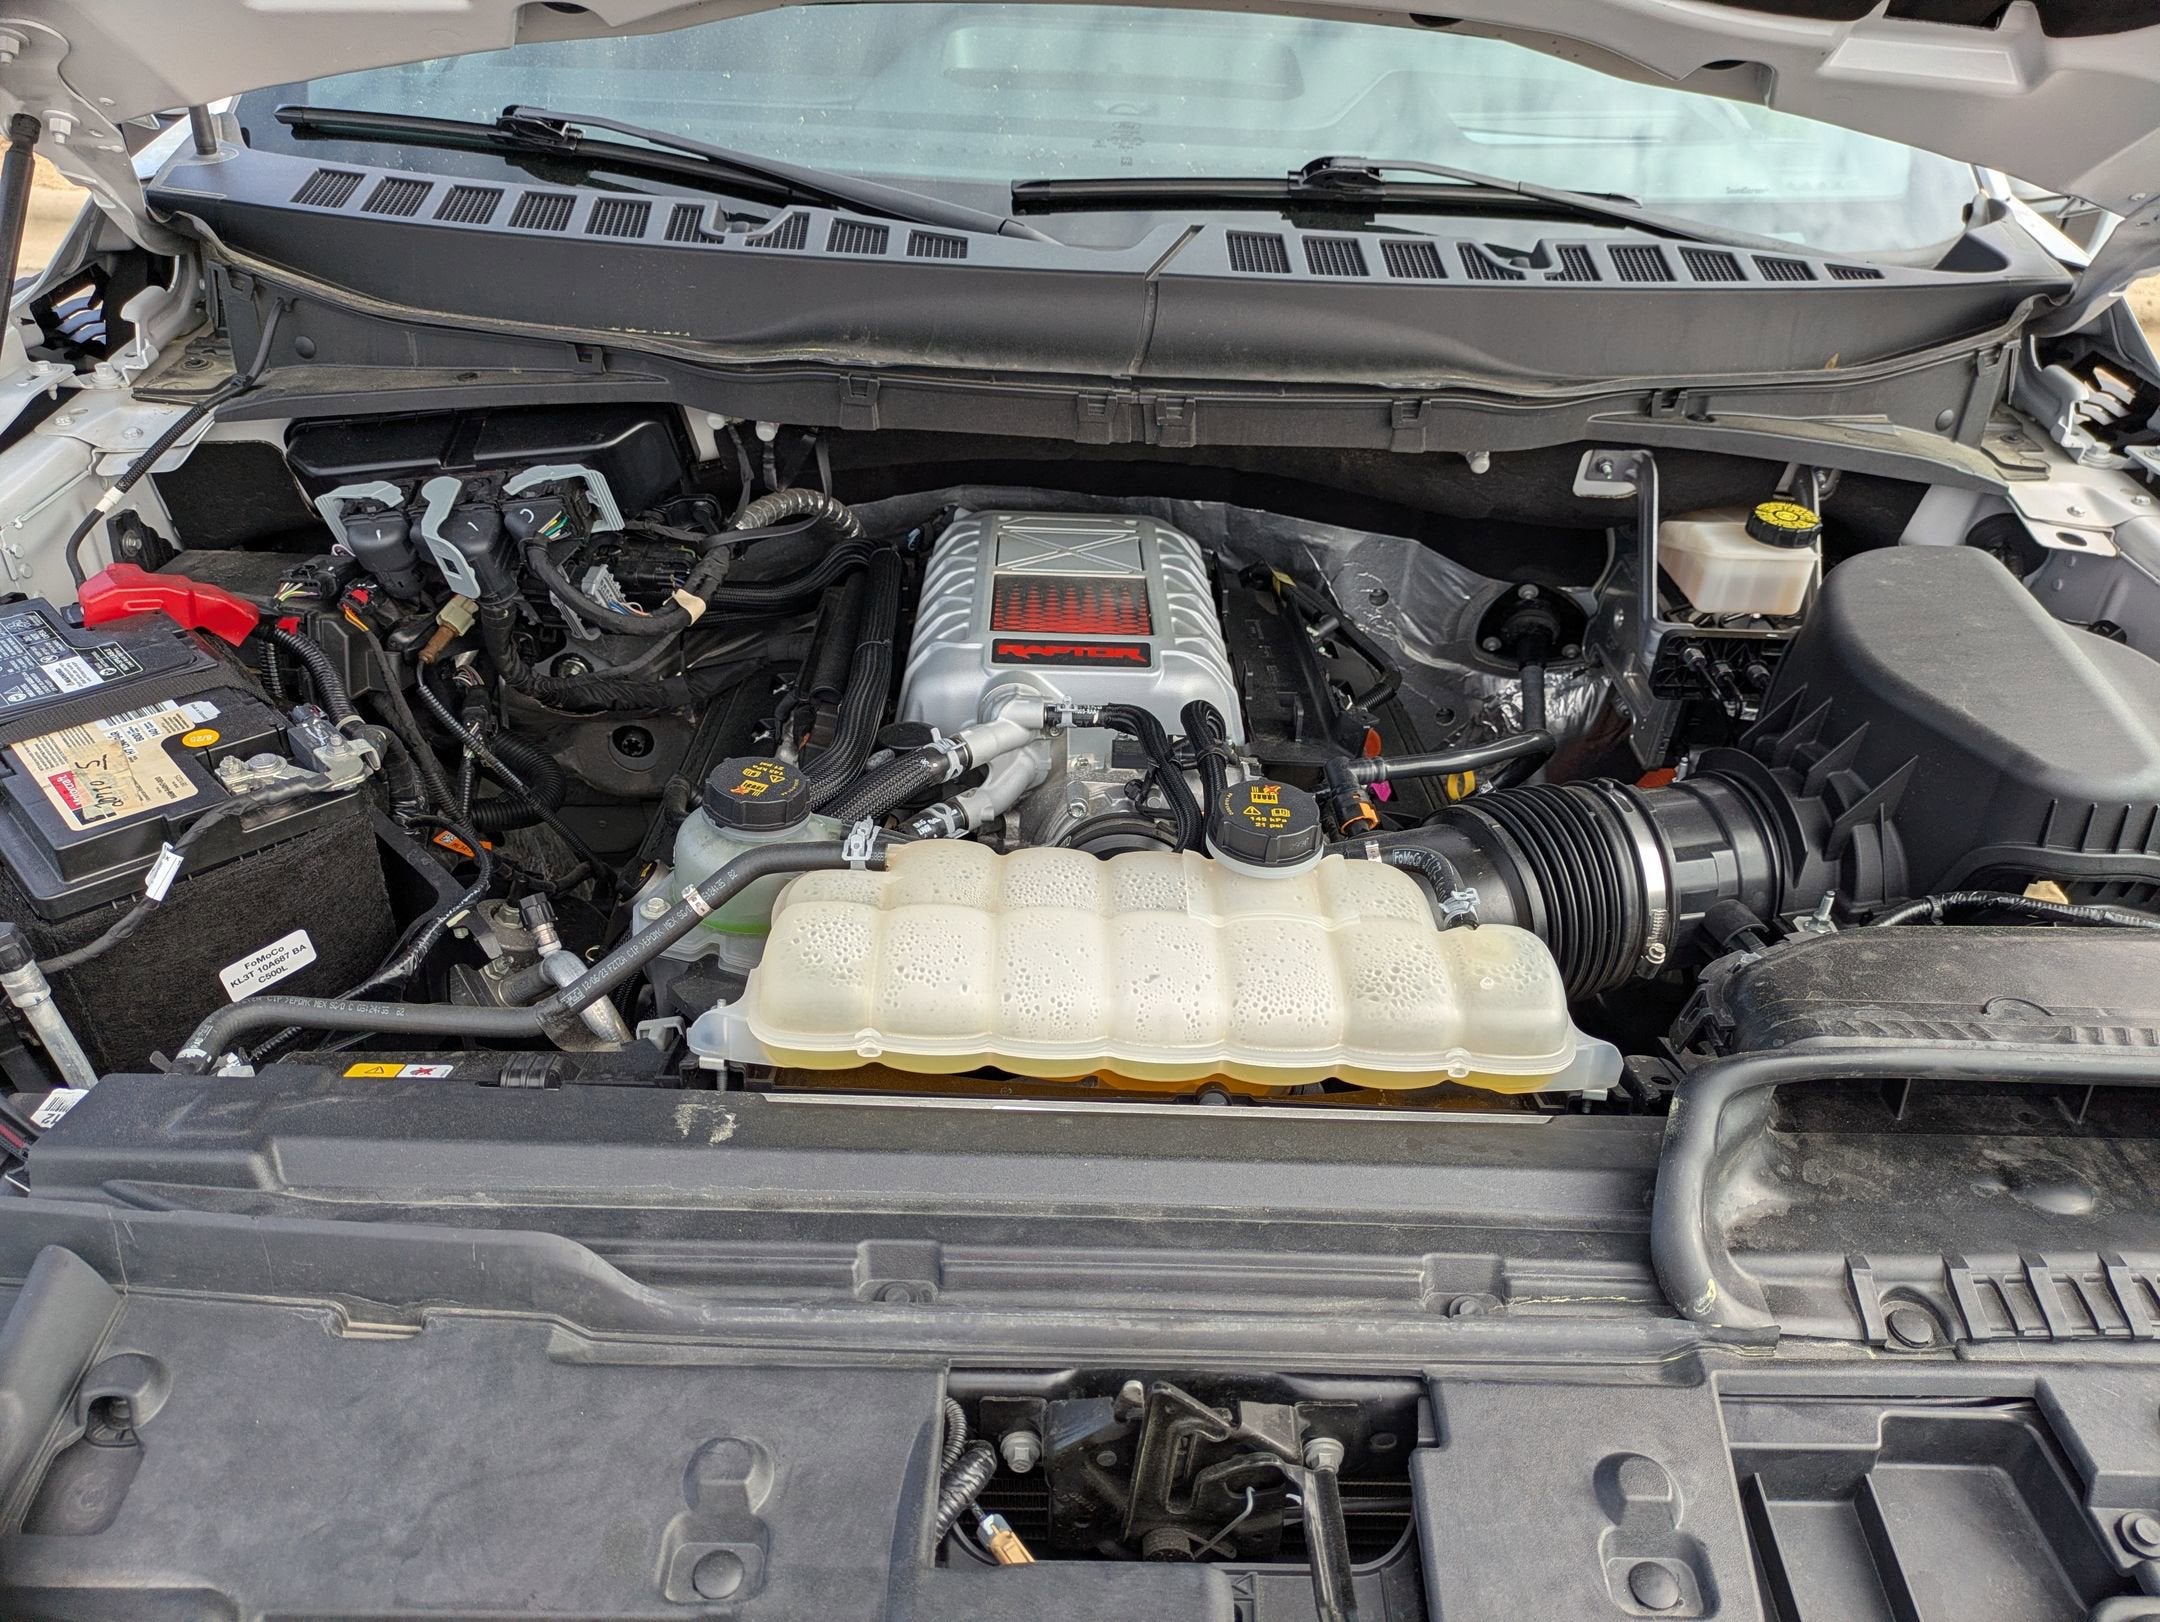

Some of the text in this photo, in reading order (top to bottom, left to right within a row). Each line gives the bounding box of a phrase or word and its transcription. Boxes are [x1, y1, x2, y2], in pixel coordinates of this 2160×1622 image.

[998, 644, 1147, 663] RAPTOR
[54, 773, 82, 805] Motorcraft
[230, 944, 307, 988] KL3T 10A687 BA
[244, 946, 285, 970] FoMoCo
[258, 964, 288, 984] C500L
